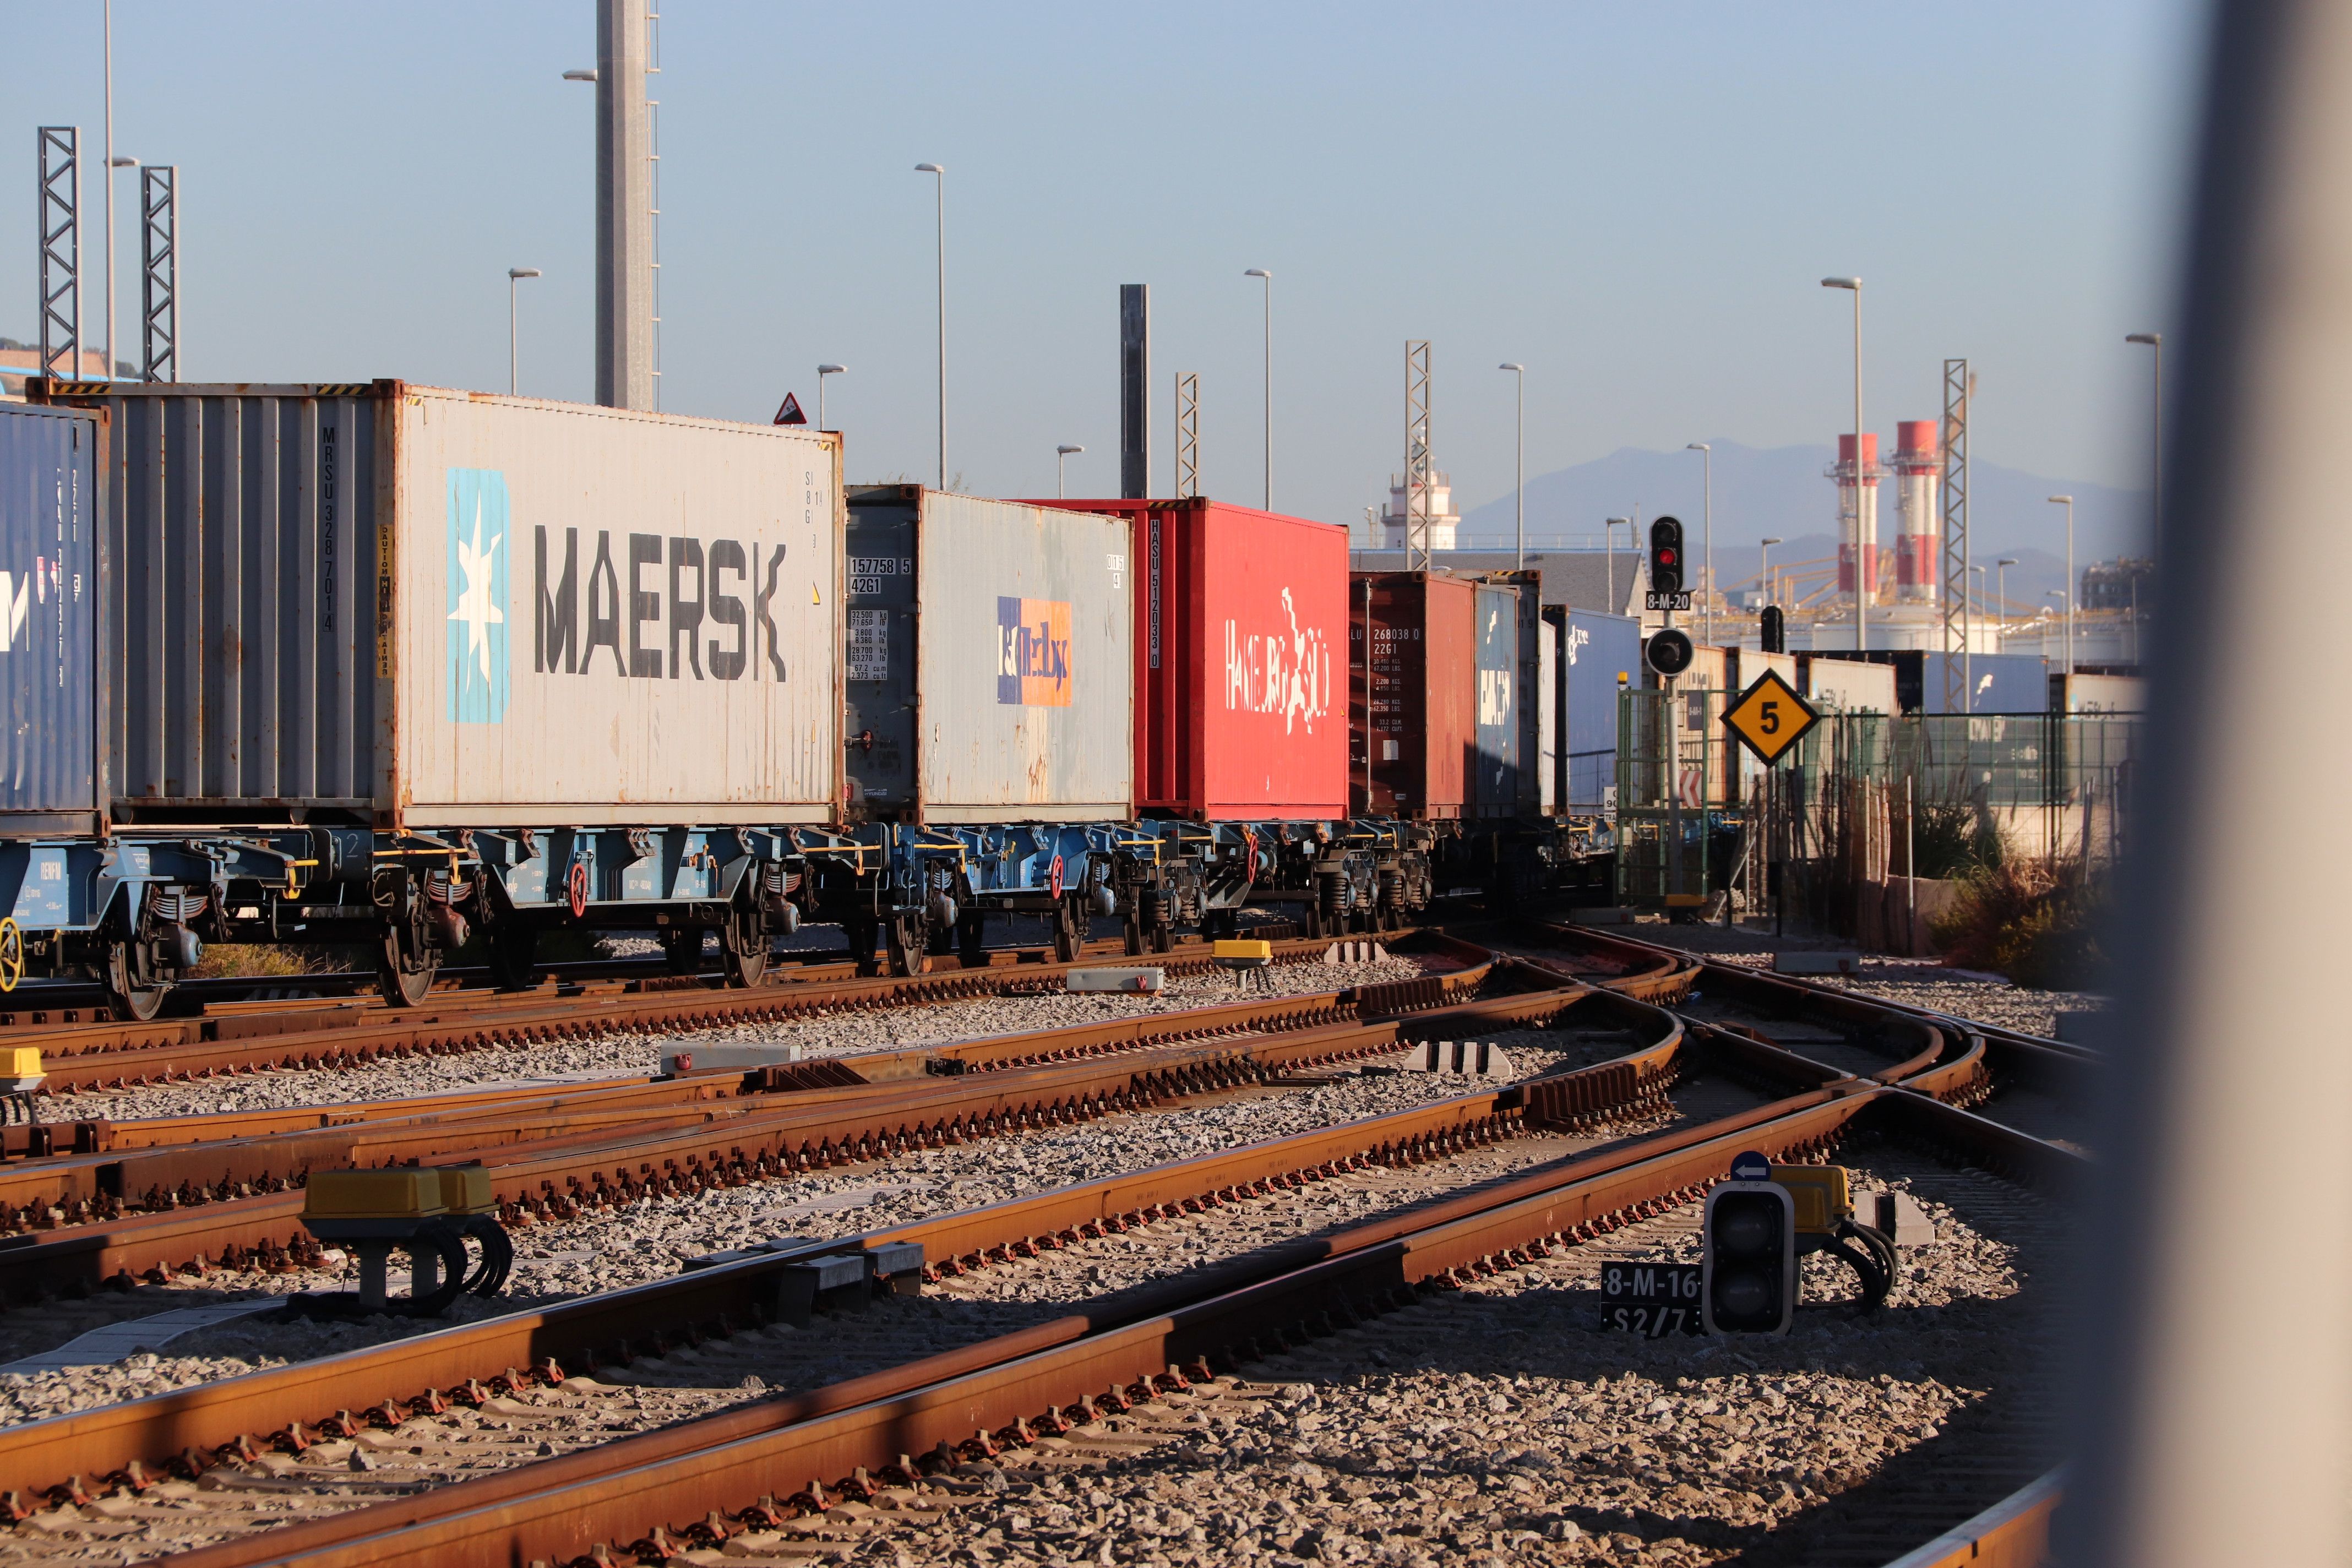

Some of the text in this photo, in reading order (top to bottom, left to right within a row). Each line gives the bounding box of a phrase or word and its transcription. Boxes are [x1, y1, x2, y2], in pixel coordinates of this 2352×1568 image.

[323, 427, 335, 499] MRSU
[852, 559, 910, 573] 157758 5
[852, 579, 879, 592] 42G1
[535, 525, 786, 683] MAERSK
[1647, 594, 1689, 609] 8-M-20
[879, 612, 887, 620] kg
[879, 629, 886, 638] kg
[1374, 629, 1409, 640] 268038
[879, 647, 887, 656] kg
[1374, 643, 1396, 654] 22G1
[1760, 701, 1779, 734] 5
[346, 833, 358, 858] 2
[1607, 1268, 1698, 1298] 8-M-16
[1614, 1306, 1686, 1337] S2/7
